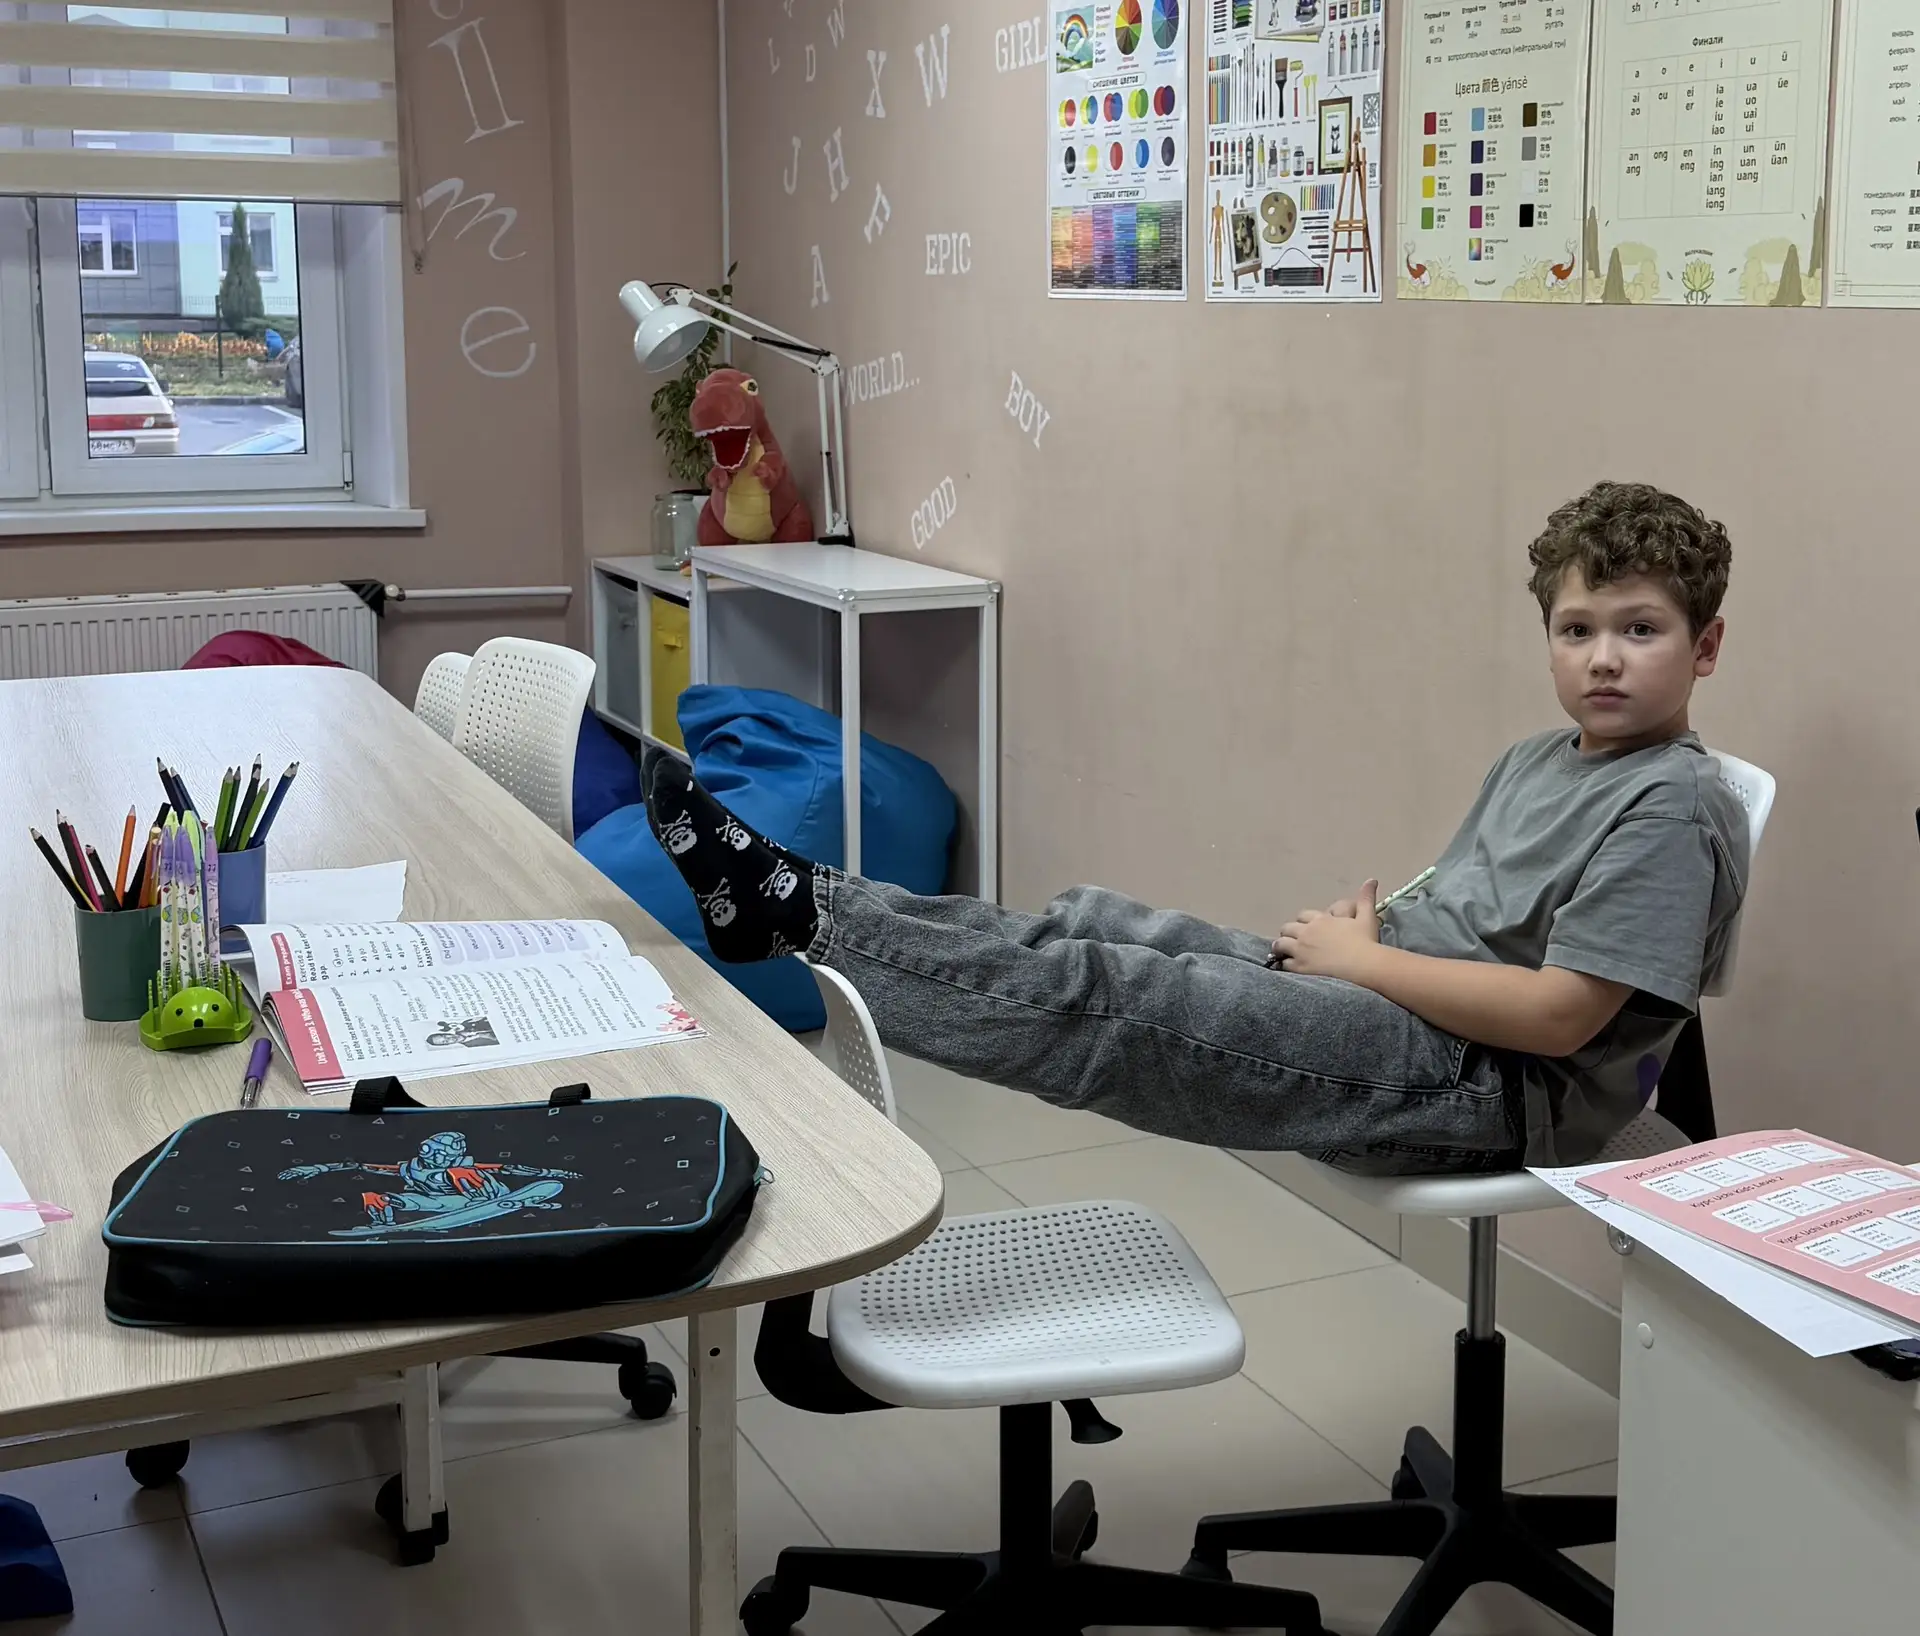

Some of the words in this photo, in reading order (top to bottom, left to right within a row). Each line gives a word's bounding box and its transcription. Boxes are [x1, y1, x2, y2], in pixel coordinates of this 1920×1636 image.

[1632, 2, 1641, 13] sh
[995, 16, 1049, 73] GIRL
[1692, 36, 1724, 46] Финали
[1888, 47, 1916, 56] февраль
[914, 23, 949, 108] W
[1720, 58, 1723, 68] i
[1750, 57, 1756, 65] u
[1661, 67, 1667, 75] o
[1688, 64, 1694, 72] e
[1893, 64, 1908, 72] март
[1635, 70, 1640, 78] a
[866, 50, 886, 118] X
[1716, 84, 1724, 94] ia
[1746, 83, 1757, 91] ua
[1888, 81, 1911, 90] апрель
[1455, 82, 1480, 98] Цвета
[1686, 86, 1694, 98] ei
[1632, 92, 1640, 103] ai
[1658, 92, 1668, 100] ou
[1745, 97, 1757, 105] uo
[1892, 97, 1905, 105] май
[1685, 102, 1694, 111] er
[1715, 97, 1724, 107] ie
[1630, 108, 1640, 116] ao
[1714, 111, 1723, 121] iu
[1743, 108, 1757, 119] uai
[1711, 125, 1725, 135] iao
[1745, 122, 1754, 132] ui
[1683, 149, 1693, 157] en
[1713, 145, 1722, 155] in
[1743, 145, 1755, 153] un
[1628, 153, 1639, 161] an
[1653, 151, 1668, 161] ong
[783, 135, 801, 195] J
[823, 126, 850, 203] H
[1680, 162, 1695, 173] eng
[1709, 158, 1724, 171] ing
[1740, 158, 1757, 167] uan
[1626, 165, 1641, 176] ang
[1709, 172, 1723, 182] ian
[1736, 172, 1759, 183] uang
[1706, 185, 1725, 197] iang
[1705, 198, 1725, 211] iong
[1871, 208, 1896, 216] вторник
[925, 232, 971, 275] EPIC
[811, 244, 829, 308] A
[1005, 369, 1050, 449] BOY
[911, 475, 956, 550] GOOD
[413, 945, 424, 968] Exercise
[423, 947, 433, 967] Match
[442, 949, 451, 959] Did
[297, 954, 307, 983] Exercise
[308, 963, 317, 981] Read
[284, 965, 292, 985] Exam
[298, 998, 308, 1008] was
[301, 1008, 312, 1021] Who
[308, 1027, 321, 1046] Lesson
[316, 1051, 328, 1065] Unit
[1624, 1171, 1648, 1182] Курс
[1686, 1152, 1709, 1163] Level
[1690, 1199, 1714, 1209] Курс
[1754, 1179, 1776, 1189] Level
[1777, 1233, 1800, 1245] Курс
[1841, 1210, 1866, 1222] Level
